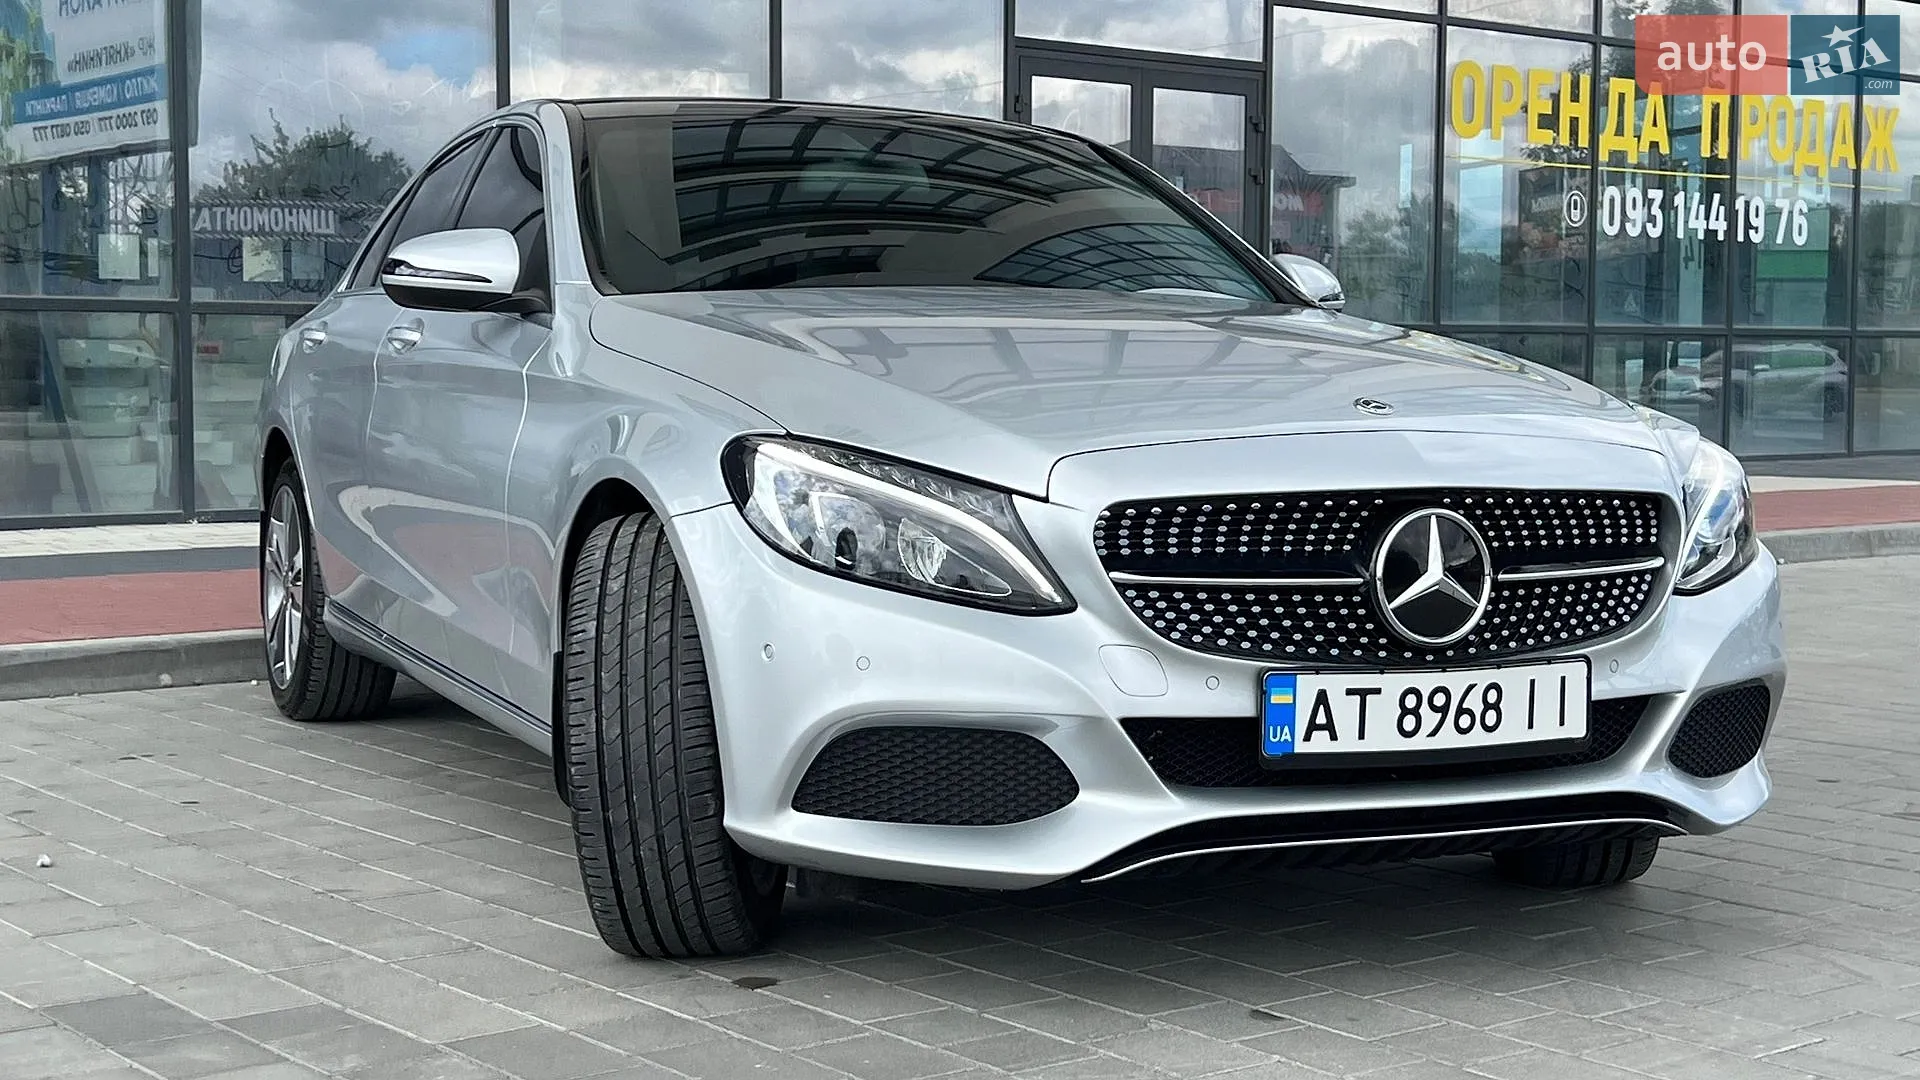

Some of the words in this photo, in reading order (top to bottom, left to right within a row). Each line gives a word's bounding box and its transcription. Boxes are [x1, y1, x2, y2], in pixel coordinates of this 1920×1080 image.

[1451, 60, 1670, 164] ОРЕНДА
[1700, 86, 1900, 178] ПРОДАЖ
[1602, 186, 1664, 238] 093
[1674, 190, 1727, 241] 144
[1735, 195, 1765, 244] 19
[1775, 199, 1808, 246] 76
[1269, 725, 1292, 742] UA
[1303, 687, 1382, 742] AT
[1397, 682, 1503, 738] 8968
